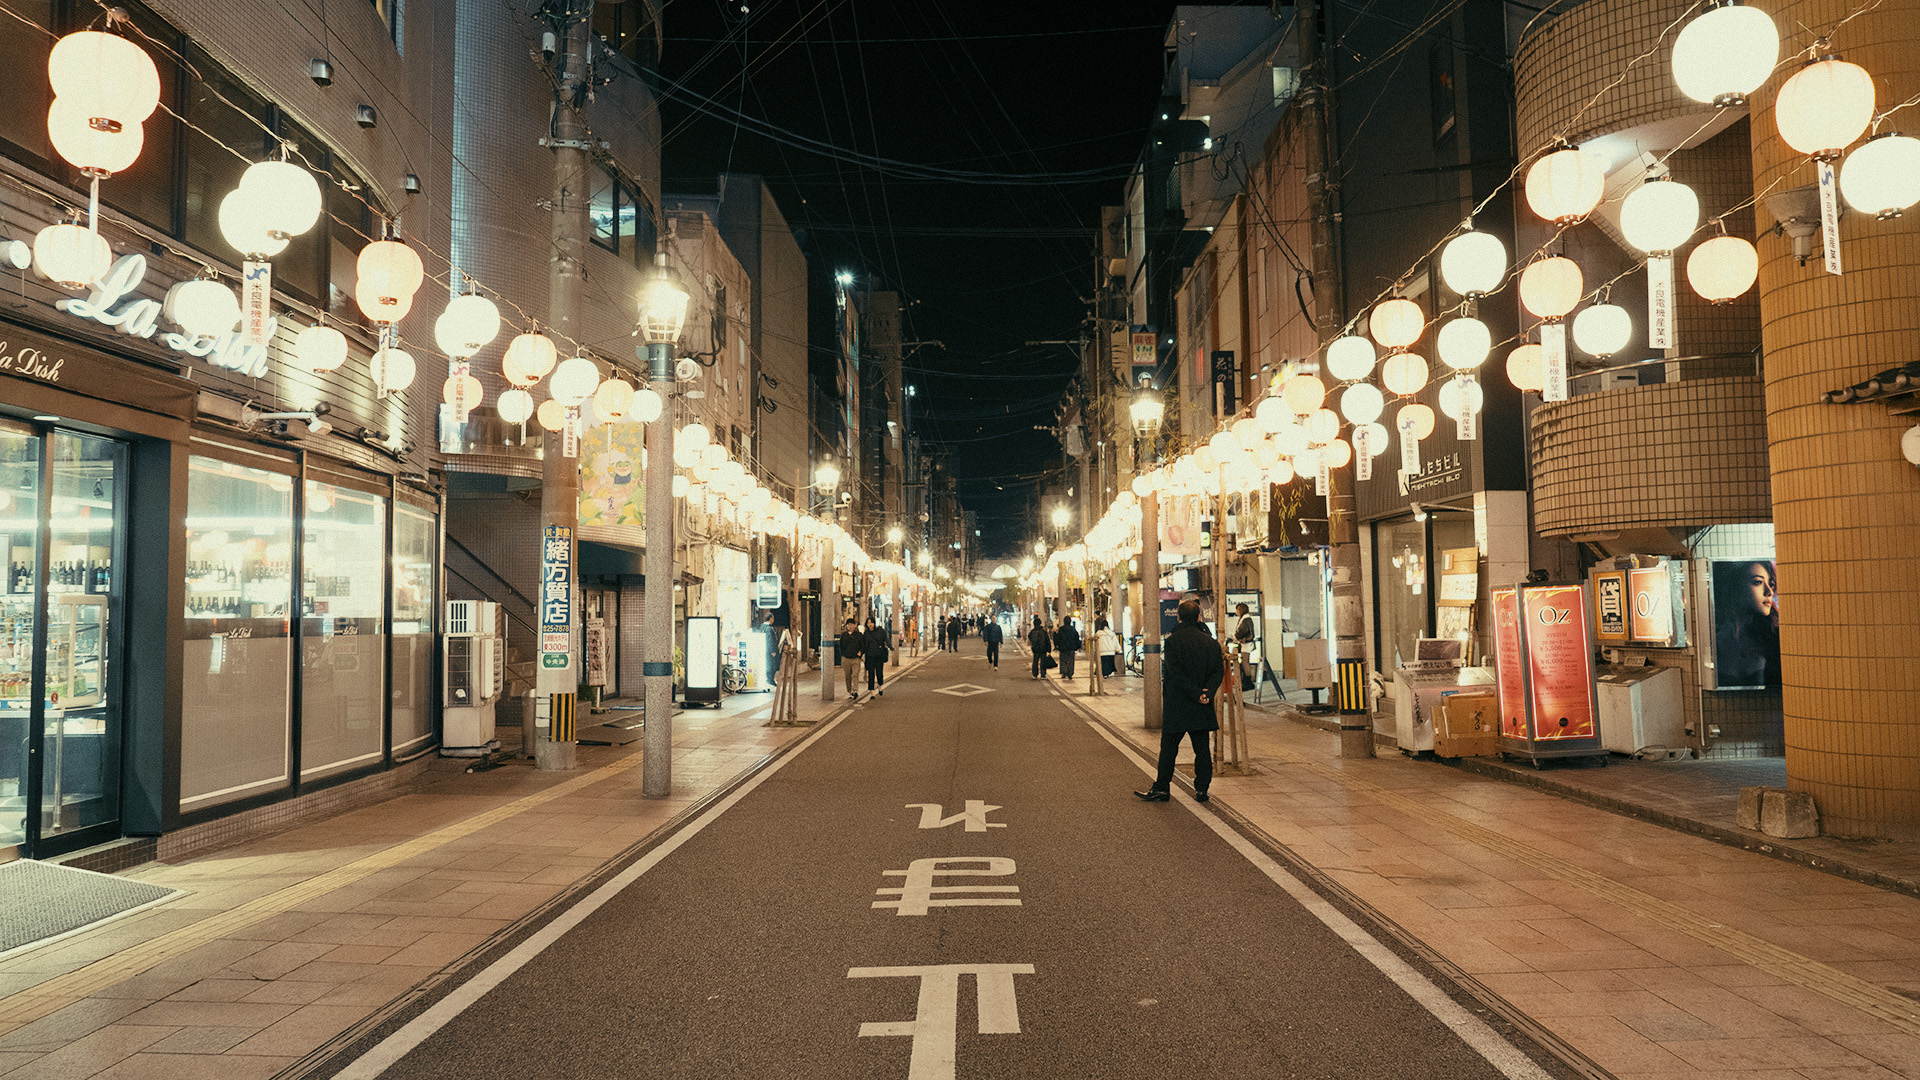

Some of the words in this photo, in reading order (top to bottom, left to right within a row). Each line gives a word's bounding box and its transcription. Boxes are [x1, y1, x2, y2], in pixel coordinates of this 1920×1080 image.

[56, 254, 163, 339] La
[15, 348, 64, 382] Dish
[544, 540, 570, 623] 緒方質店
[1600, 581, 1621, 617] 貸
[1499, 608, 1513, 627] Oz
[1538, 605, 1571, 626] Oz
